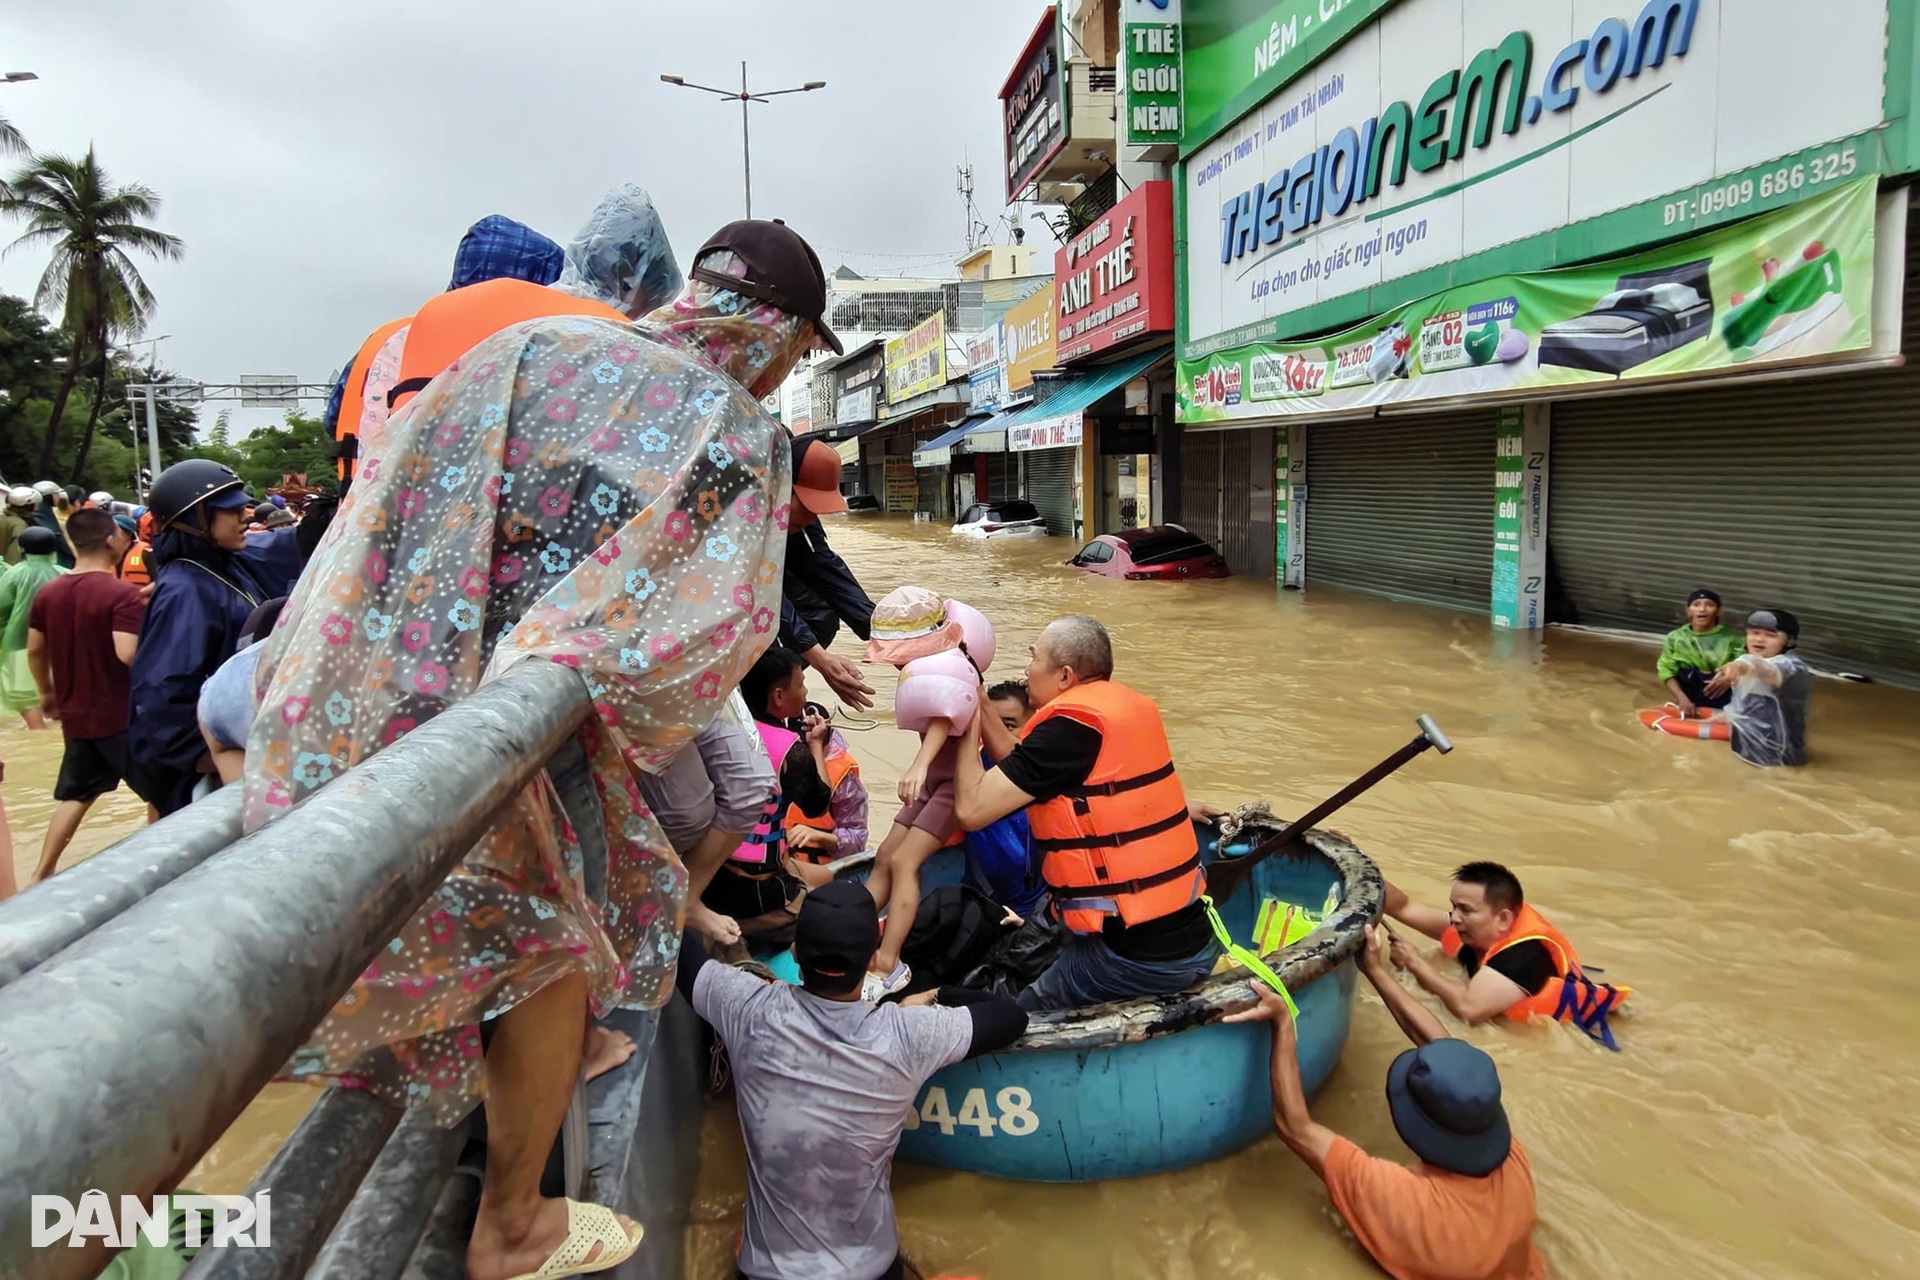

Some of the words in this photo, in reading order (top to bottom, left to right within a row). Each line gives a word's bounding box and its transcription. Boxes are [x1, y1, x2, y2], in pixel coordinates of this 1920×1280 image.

[1254, 14, 1297, 78] NỆM
[1132, 63, 1178, 93] GIỚI
[1133, 101, 1179, 136] NỆM
[1206, 158, 1223, 179] CÔNG
[1223, 151, 1233, 170] TY
[1234, 137, 1253, 163] TNHH
[1267, 119, 1279, 142] DV
[1301, 92, 1317, 119] TÀI
[1318, 73, 1345, 109] NHÂN
[1664, 199, 1696, 227] ĐT:
[1701, 178, 1754, 216] 0909
[1759, 163, 1805, 199] 686
[1809, 147, 1857, 185] 325
[1060, 267, 1093, 318] ANH
[1096, 215, 1136, 297] THẾ
[1251, 278, 1270, 303] Lựa
[1271, 269, 1297, 295] chọn
[1300, 258, 1321, 282] cho
[1324, 240, 1352, 281] giấc
[1354, 227, 1383, 268] ngủ
[1385, 218, 1428, 256] ngon
[1494, 300, 1516, 317] 116k
[1421, 330, 1442, 350] TẶNG
[1443, 319, 1463, 347] 02
[1337, 344, 1374, 369] 16.000
[1207, 363, 1225, 404] 16
[1032, 428, 1048, 447] ANH
[1050, 418, 1066, 444] THẾ
[1497, 434, 1523, 460] NỆM
[1495, 471, 1523, 489] DRAP
